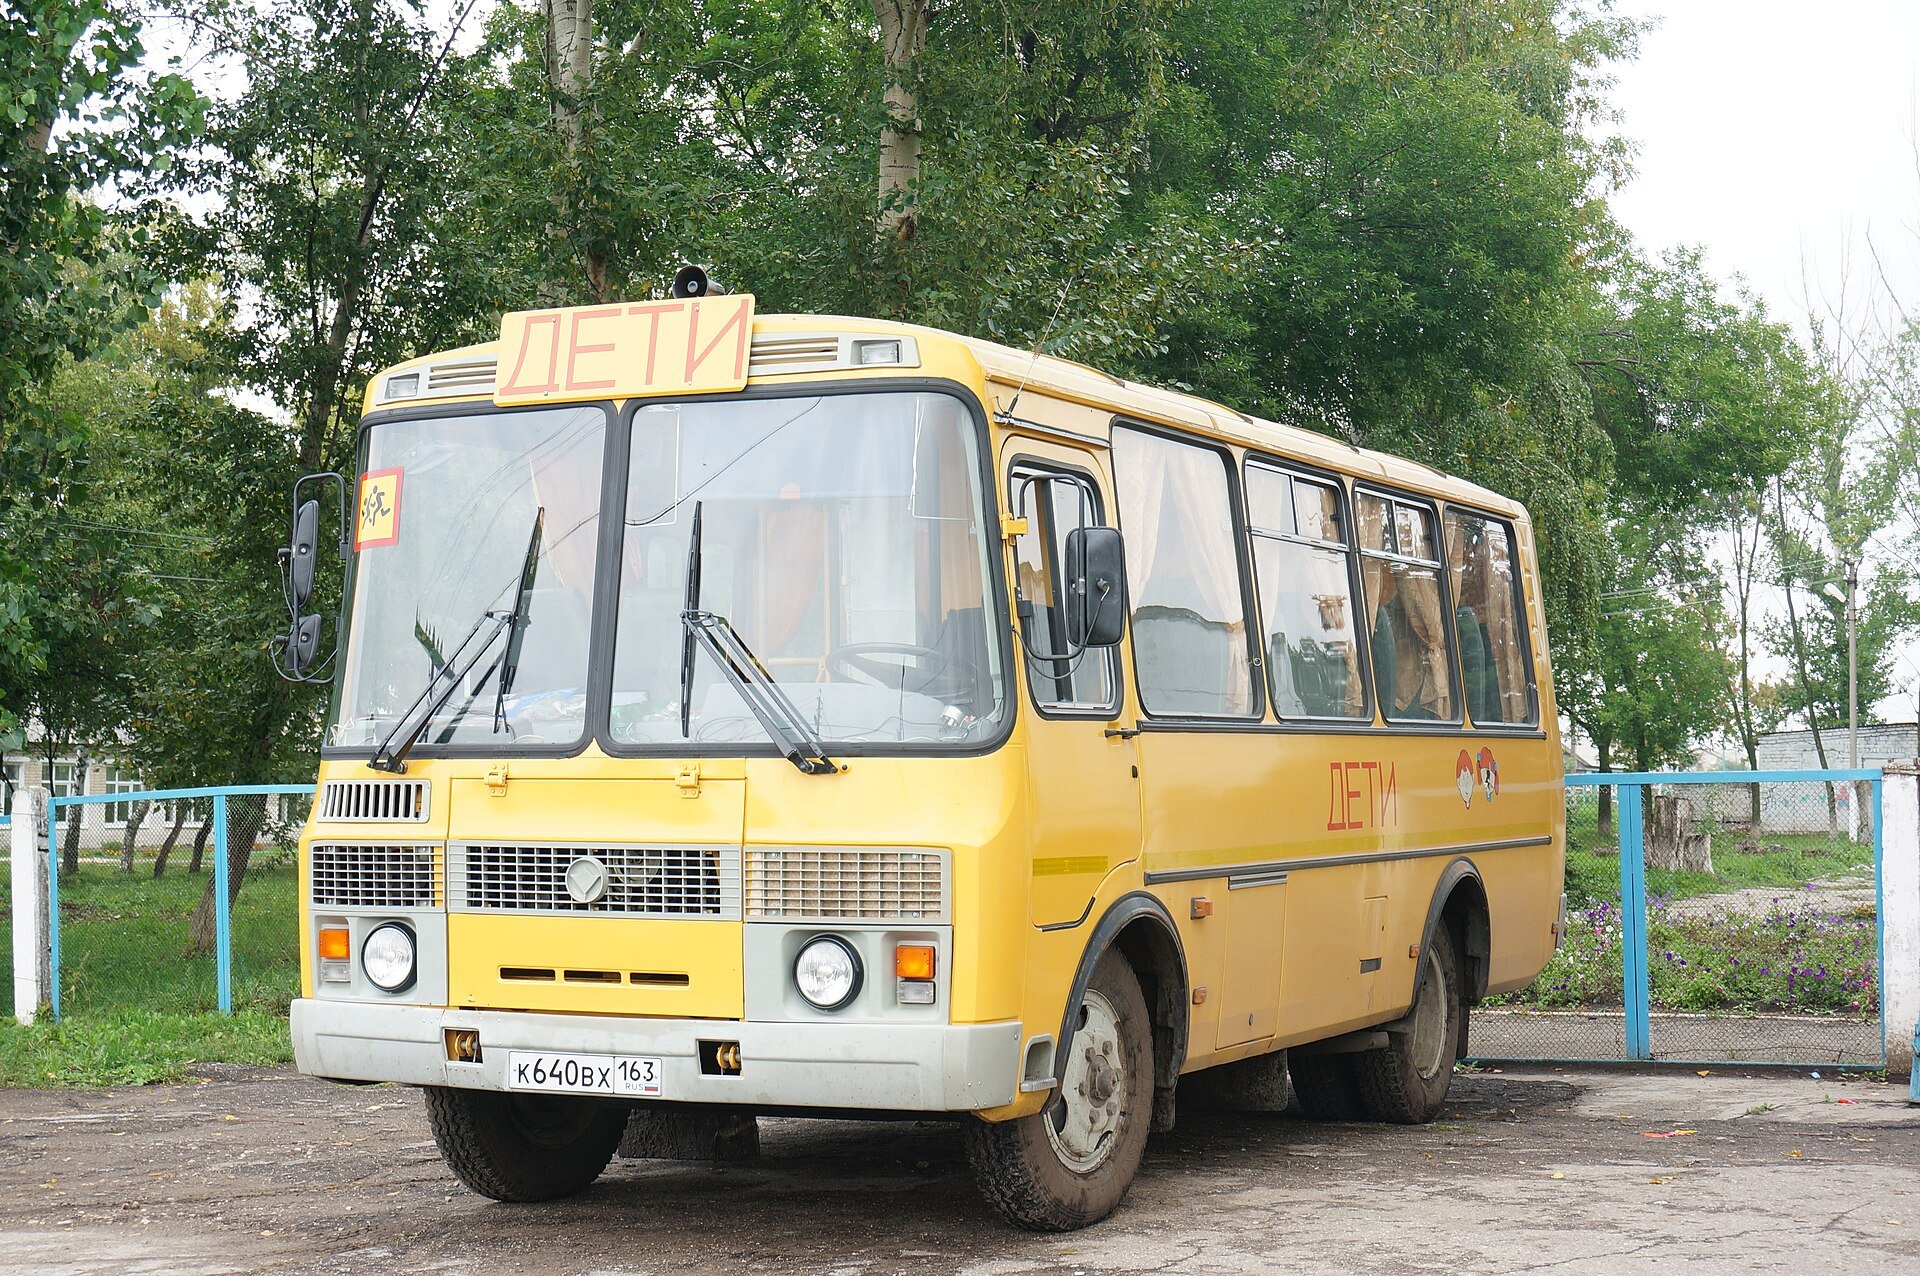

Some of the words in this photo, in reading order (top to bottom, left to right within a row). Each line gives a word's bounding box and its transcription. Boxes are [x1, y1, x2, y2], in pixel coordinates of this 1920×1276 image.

[499, 299, 749, 396] ДЕТИ
[1327, 761, 1397, 831] ДЕТИ
[618, 1060, 654, 1082] 163
[625, 1082, 644, 1091] RUS
